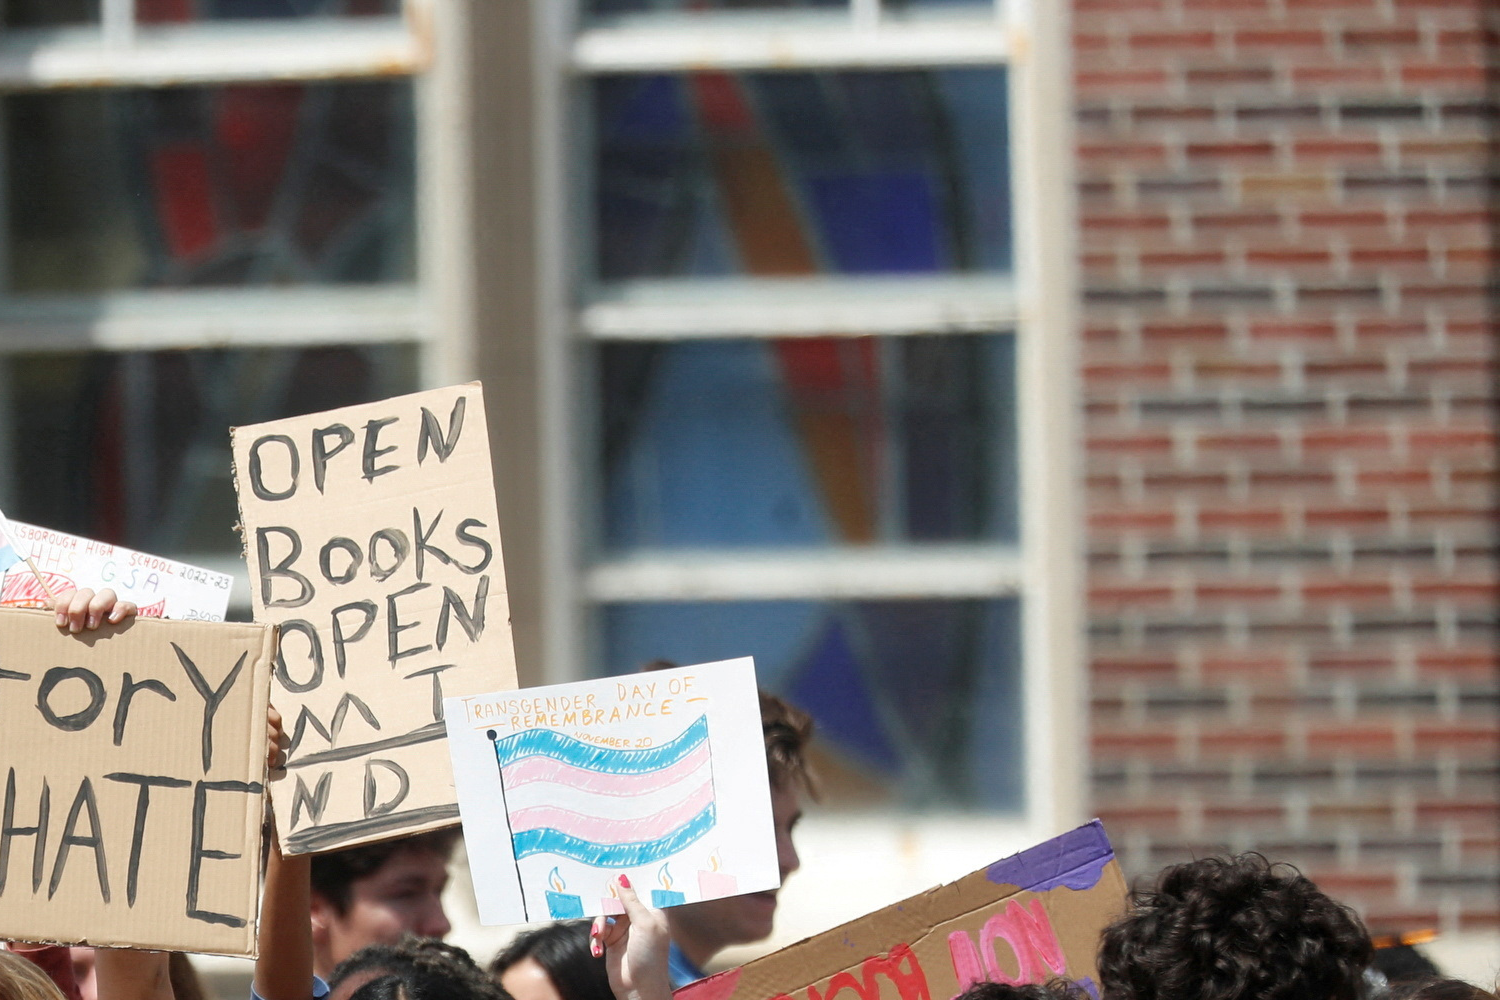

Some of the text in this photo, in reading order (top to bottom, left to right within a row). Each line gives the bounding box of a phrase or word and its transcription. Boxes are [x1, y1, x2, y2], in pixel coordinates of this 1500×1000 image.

[249, 397, 466, 501] OPEN
[85, 540, 114, 557] HIGH
[128, 552, 174, 575] SCHOOL
[180, 566, 230, 590] 2022-23
[101, 561, 159, 593] GSA
[256, 507, 493, 608] BOOKS
[276, 575, 490, 692] OPEN
[461, 676, 695, 723] TRANSGENDER DAY OF
[510, 699, 674, 731] REMEMBRANCE
[574, 730, 653, 749] NOVEMBER 20
[289, 757, 410, 833] ND
